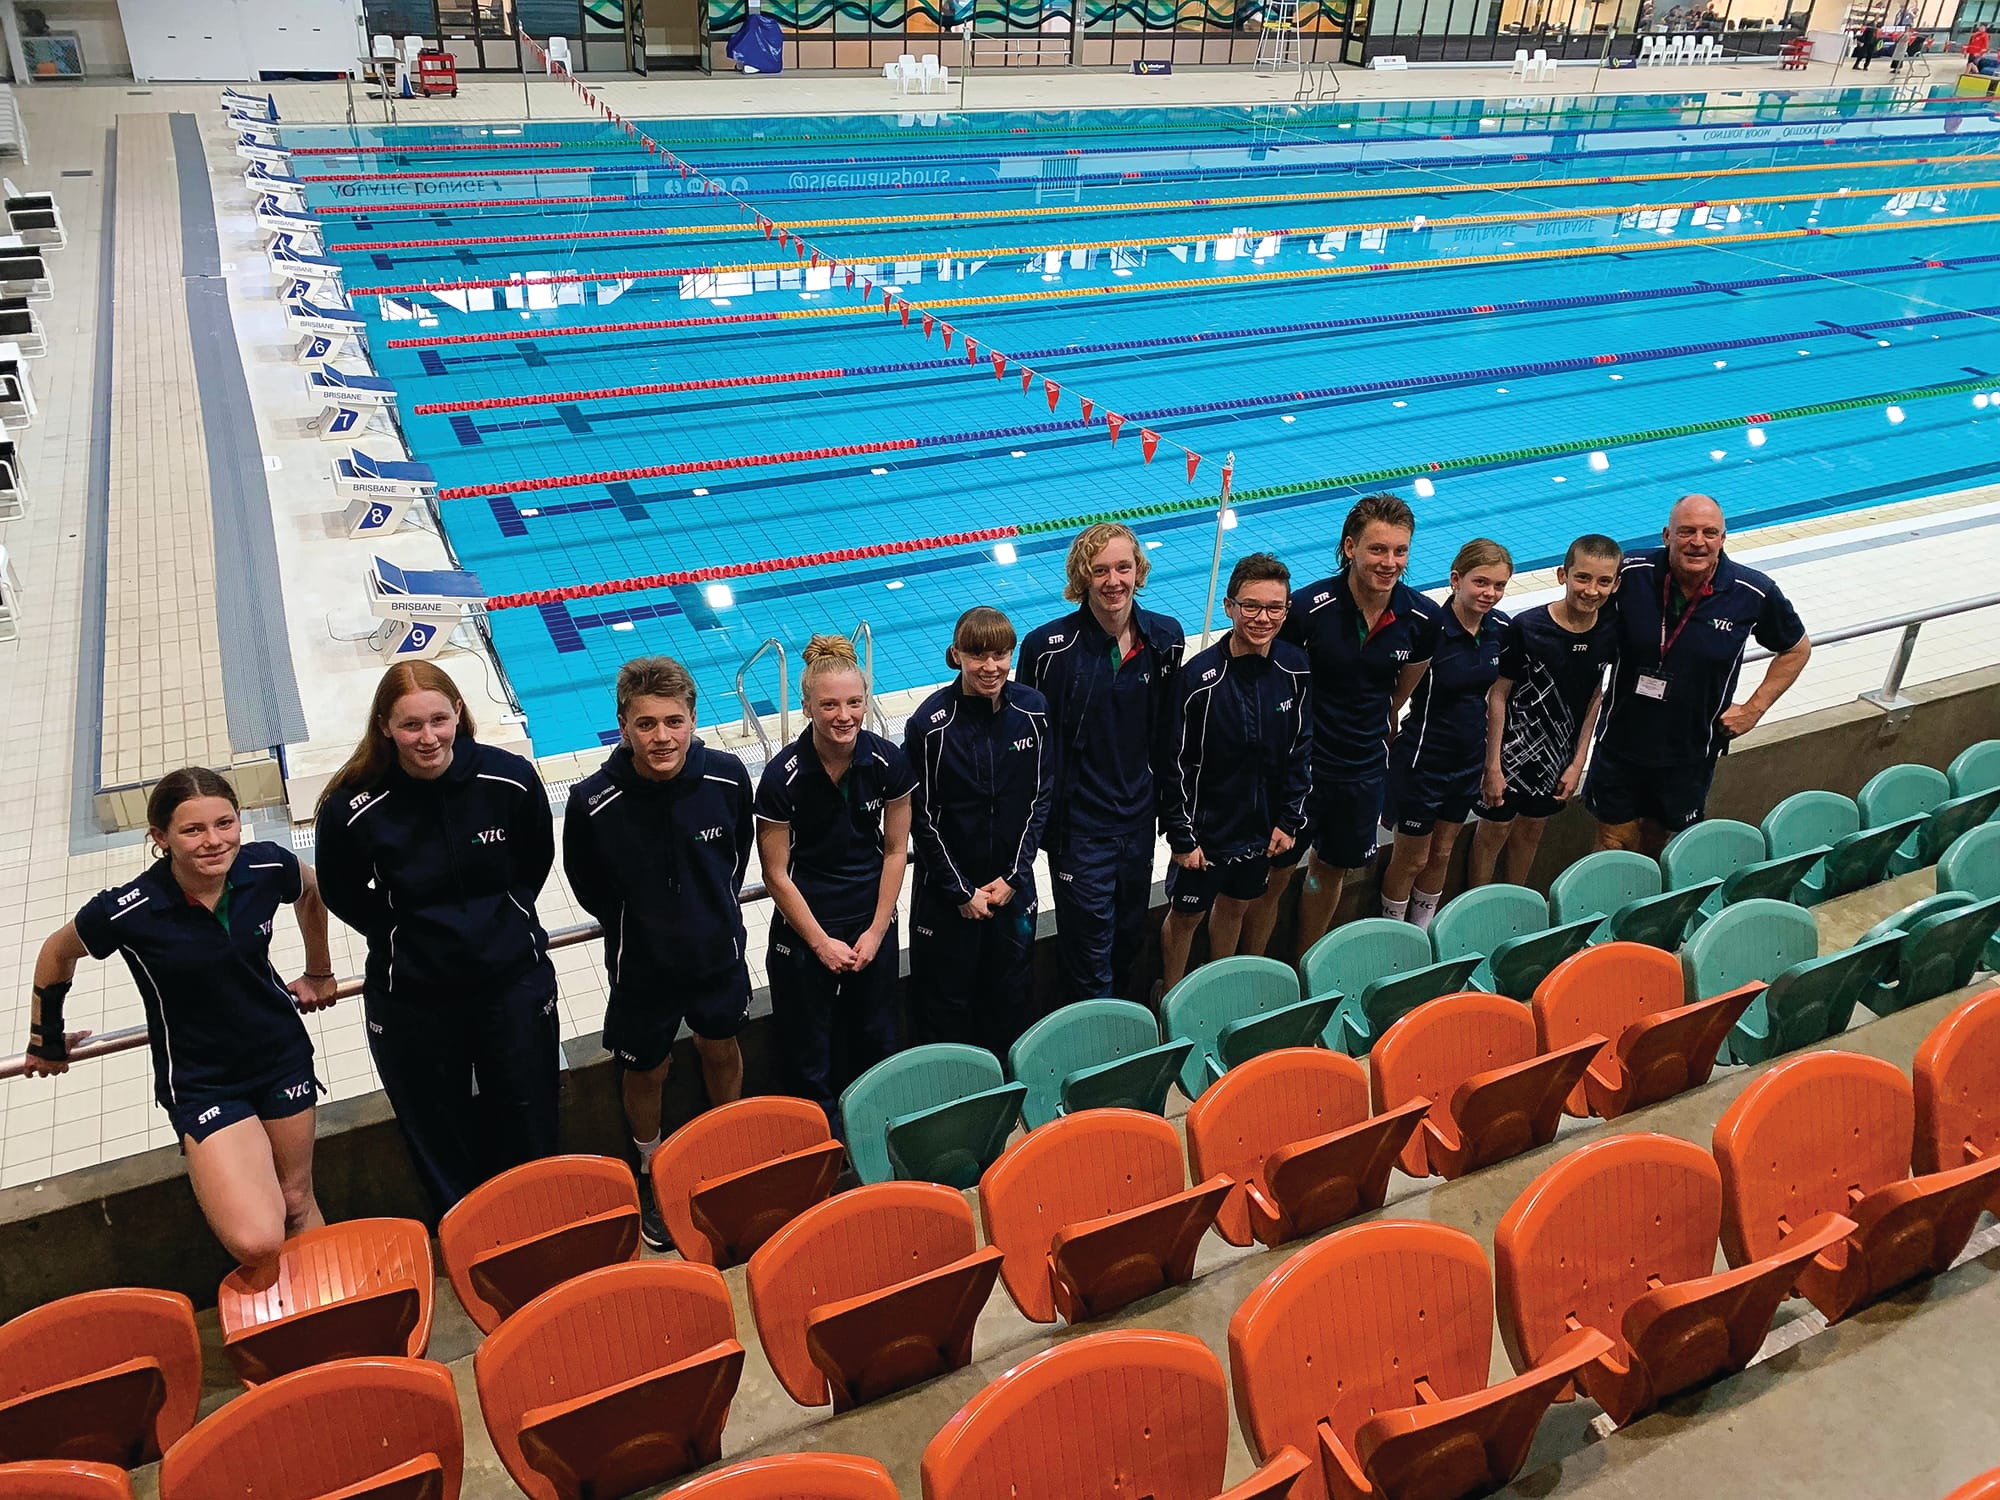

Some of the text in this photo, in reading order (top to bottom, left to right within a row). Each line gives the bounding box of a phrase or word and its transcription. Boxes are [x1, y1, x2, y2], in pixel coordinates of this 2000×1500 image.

[283, 264, 313, 273] BRISBANE
[295, 283, 305, 296] 5
[300, 321, 334, 330] BRISBANE
[314, 341, 325, 354] 6
[323, 391, 362, 400] BRISBANE
[340, 413, 350, 428] 7
[353, 484, 397, 493] BRISBANE
[371, 508, 383, 524] 8
[1313, 592, 1330, 604] STR
[391, 602, 442, 611] BRISBANE
[412, 629, 426, 647] 9
[1048, 634, 1064, 645] STR
[1572, 643, 1589, 652] STR
[1201, 668, 1217, 681] STR
[930, 708, 947, 724] STR
[349, 791, 371, 810] STR
[117, 887, 141, 906] STR
[198, 1105, 222, 1125] STR
